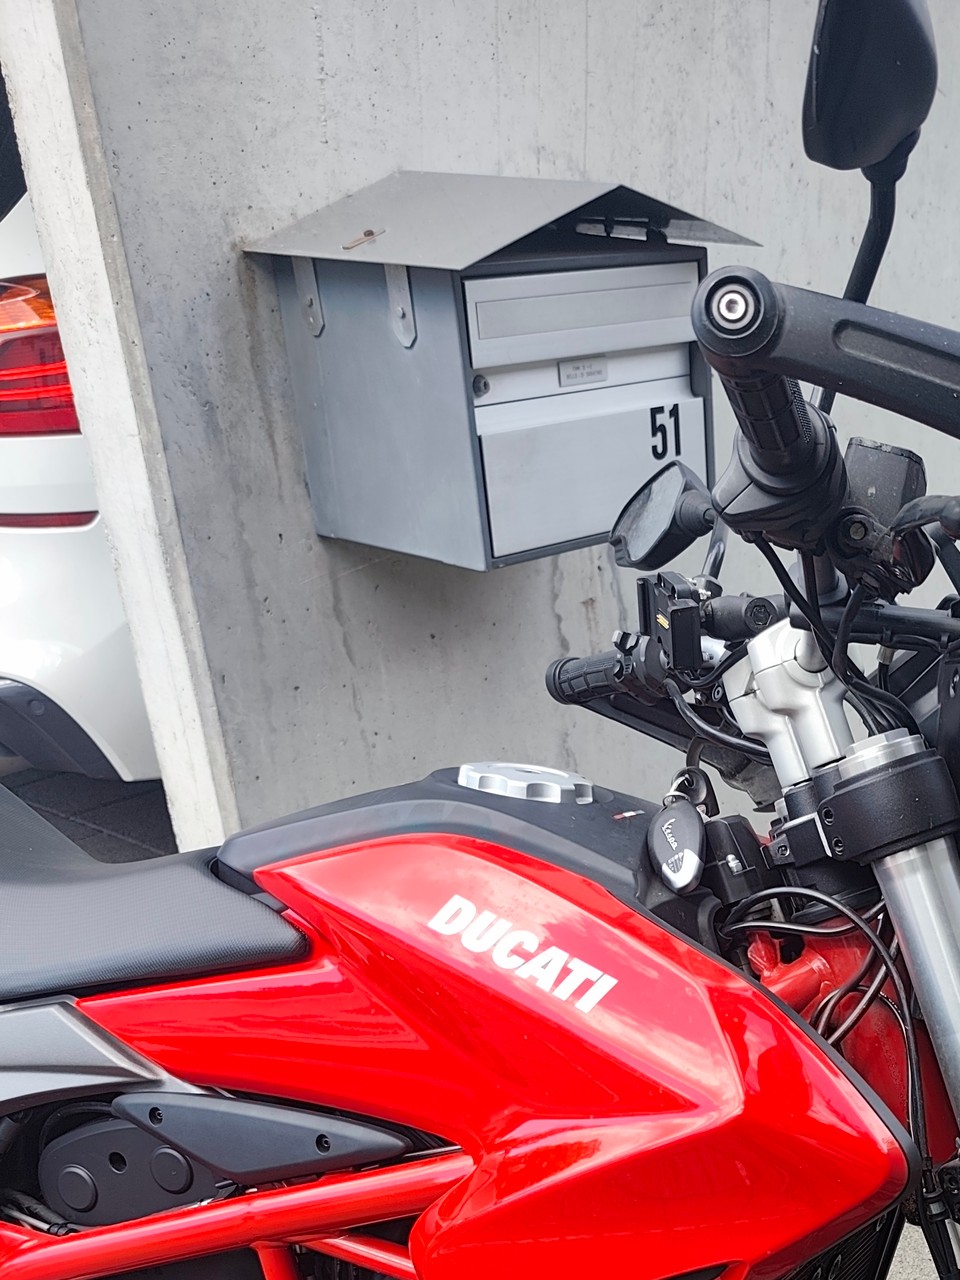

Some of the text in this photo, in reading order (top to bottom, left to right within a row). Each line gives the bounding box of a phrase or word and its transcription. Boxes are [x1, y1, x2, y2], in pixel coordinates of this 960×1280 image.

[649, 403, 682, 461] 51
[661, 818, 678, 851] Vespa
[427, 894, 619, 1014] DUCATI
